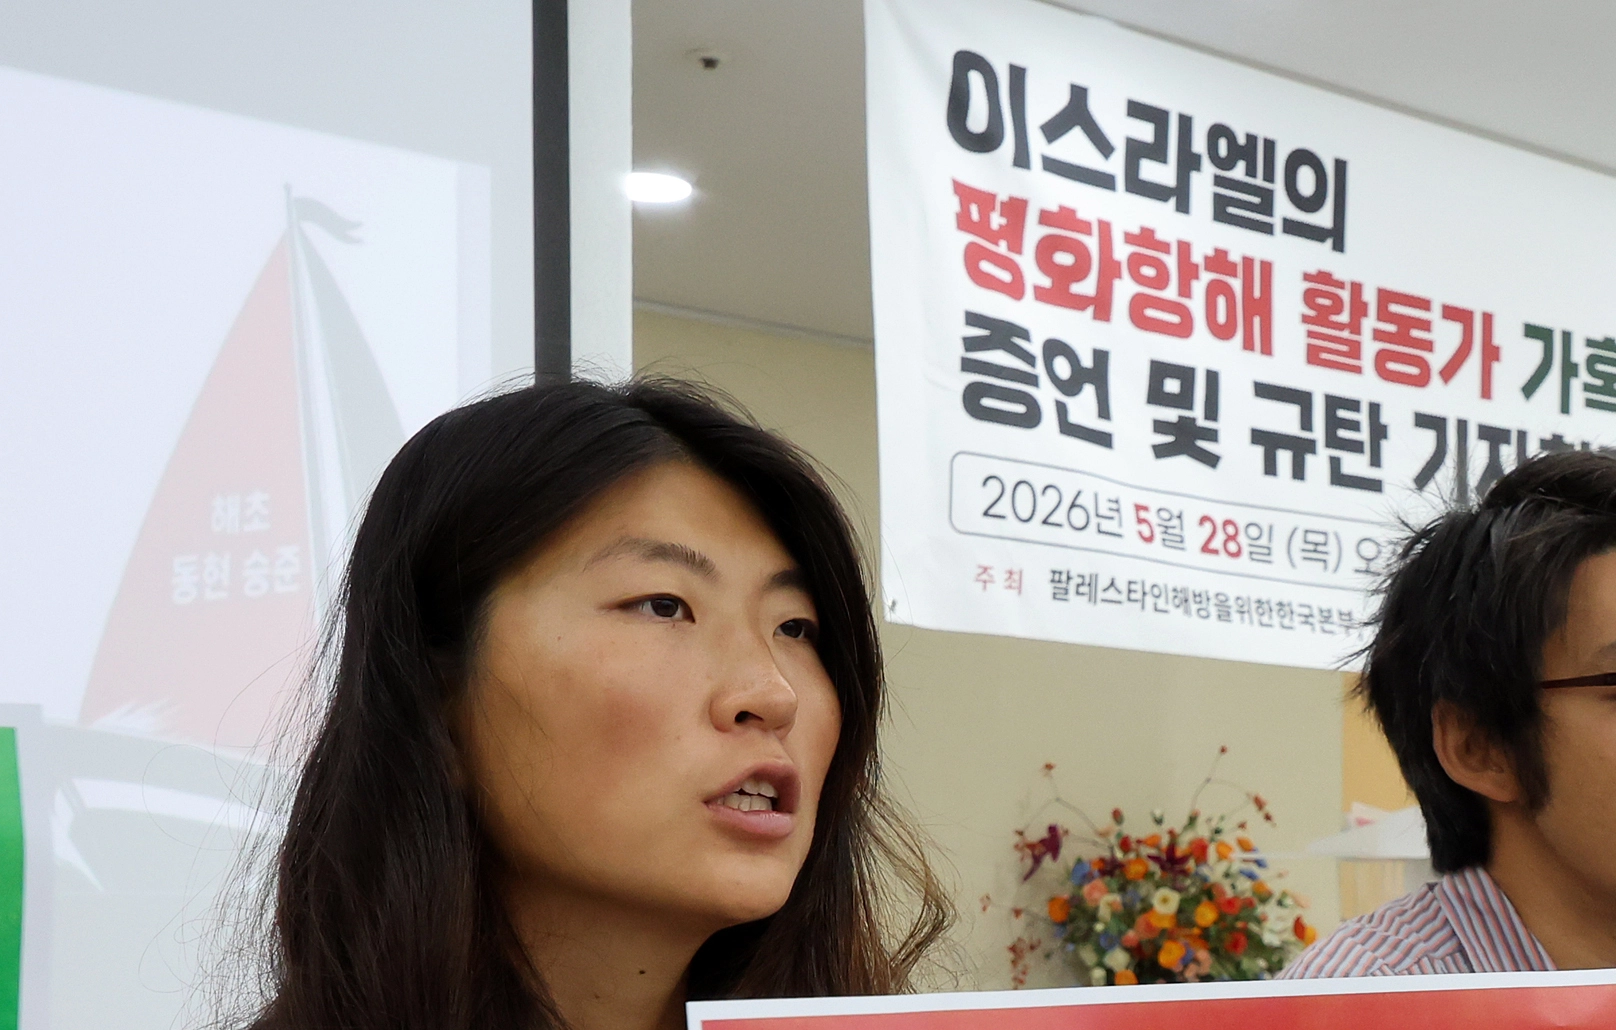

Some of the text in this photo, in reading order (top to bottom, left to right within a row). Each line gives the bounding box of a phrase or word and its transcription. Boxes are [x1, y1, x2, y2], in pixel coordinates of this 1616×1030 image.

[946, 49, 1348, 253] 이스라엘의
[952, 178, 1274, 358] 평화항해
[1301, 268, 1502, 401] 활동가
[960, 310, 1112, 450] 증언
[1147, 359, 1220, 471] 및
[1252, 378, 1387, 494] 규탄
[171, 544, 303, 605] 동현 승준
[210, 490, 272, 535] 해초
[981, 473, 1385, 577] 2026년 5월 28일 (목) 오
